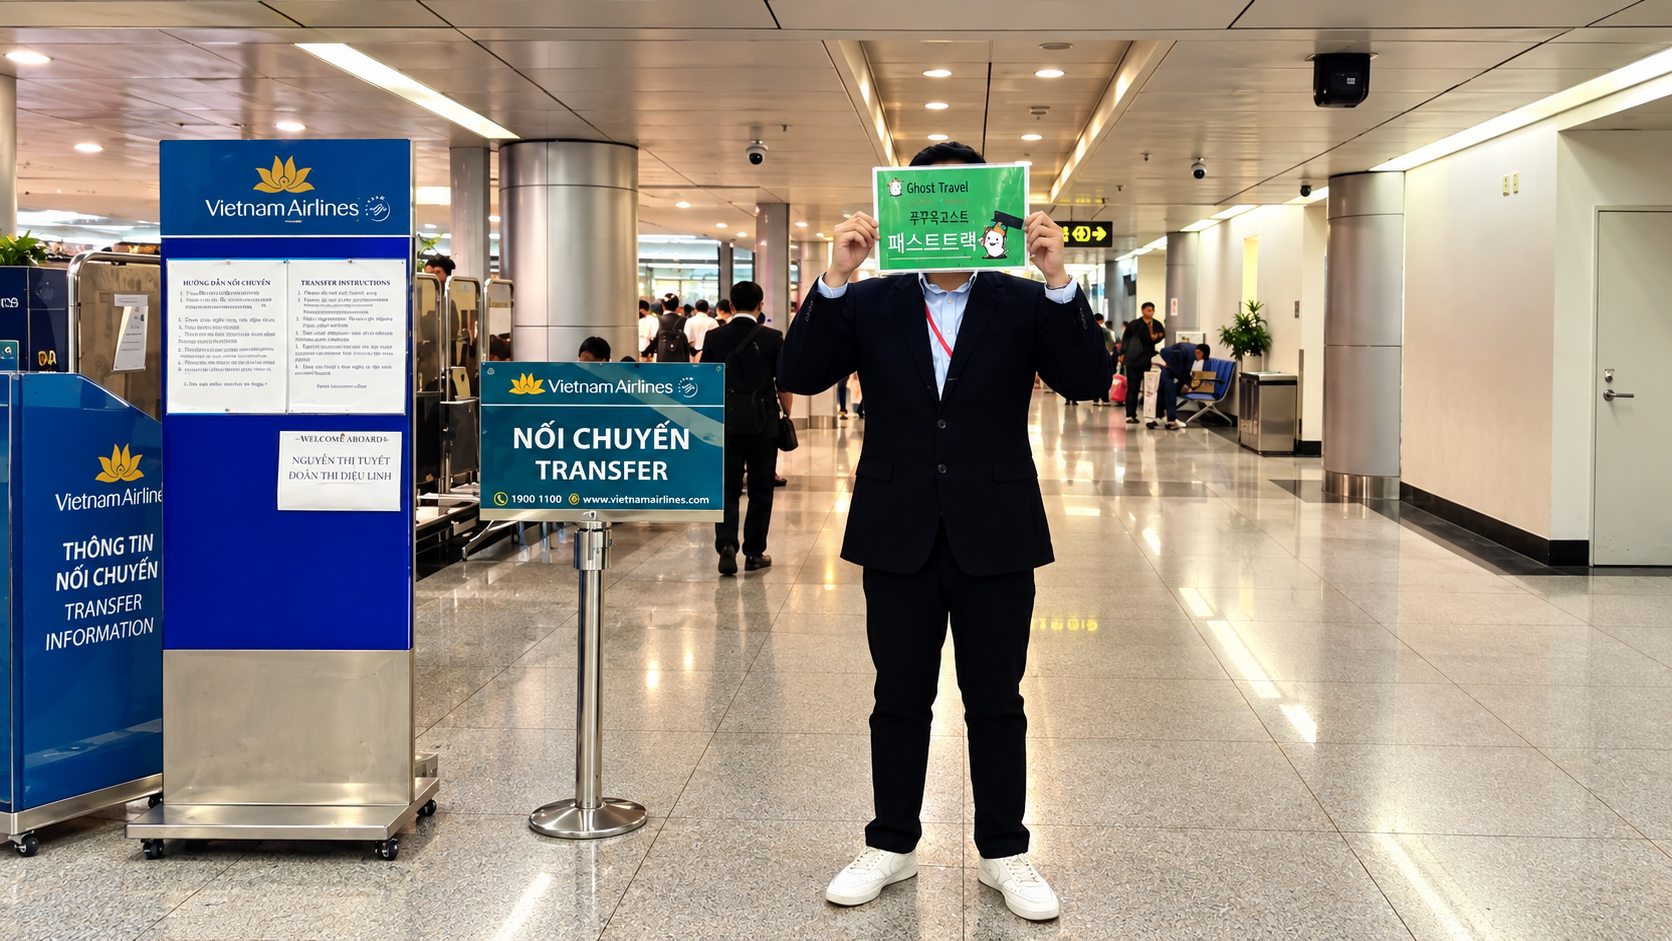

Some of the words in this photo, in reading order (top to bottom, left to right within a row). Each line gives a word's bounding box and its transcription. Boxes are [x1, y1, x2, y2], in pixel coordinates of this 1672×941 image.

[906, 182, 936, 194] Ghost
[938, 180, 969, 194] Travel
[205, 199, 285, 217] Vietnam
[287, 198, 360, 217] Airlines
[547, 379, 613, 394] Vietnam
[615, 379, 674, 394] Airlines
[513, 420, 564, 449] NỐI
[573, 420, 690, 450] CHUYẾN
[367, 471, 392, 481] LINH
[535, 460, 668, 481] TRANSFER
[55, 493, 121, 512] Vietnam
[511, 494, 536, 504] 1900
[538, 494, 562, 504] 1100
[582, 494, 710, 505] www.vietnamairlines.com
[62, 535, 125, 561] THÔNG
[128, 533, 154, 554] TIN
[55, 563, 89, 592] NỐI
[92, 556, 159, 587] CHUYẾN
[64, 593, 142, 621] TRANSFER
[45, 617, 154, 651] INFORMATION
